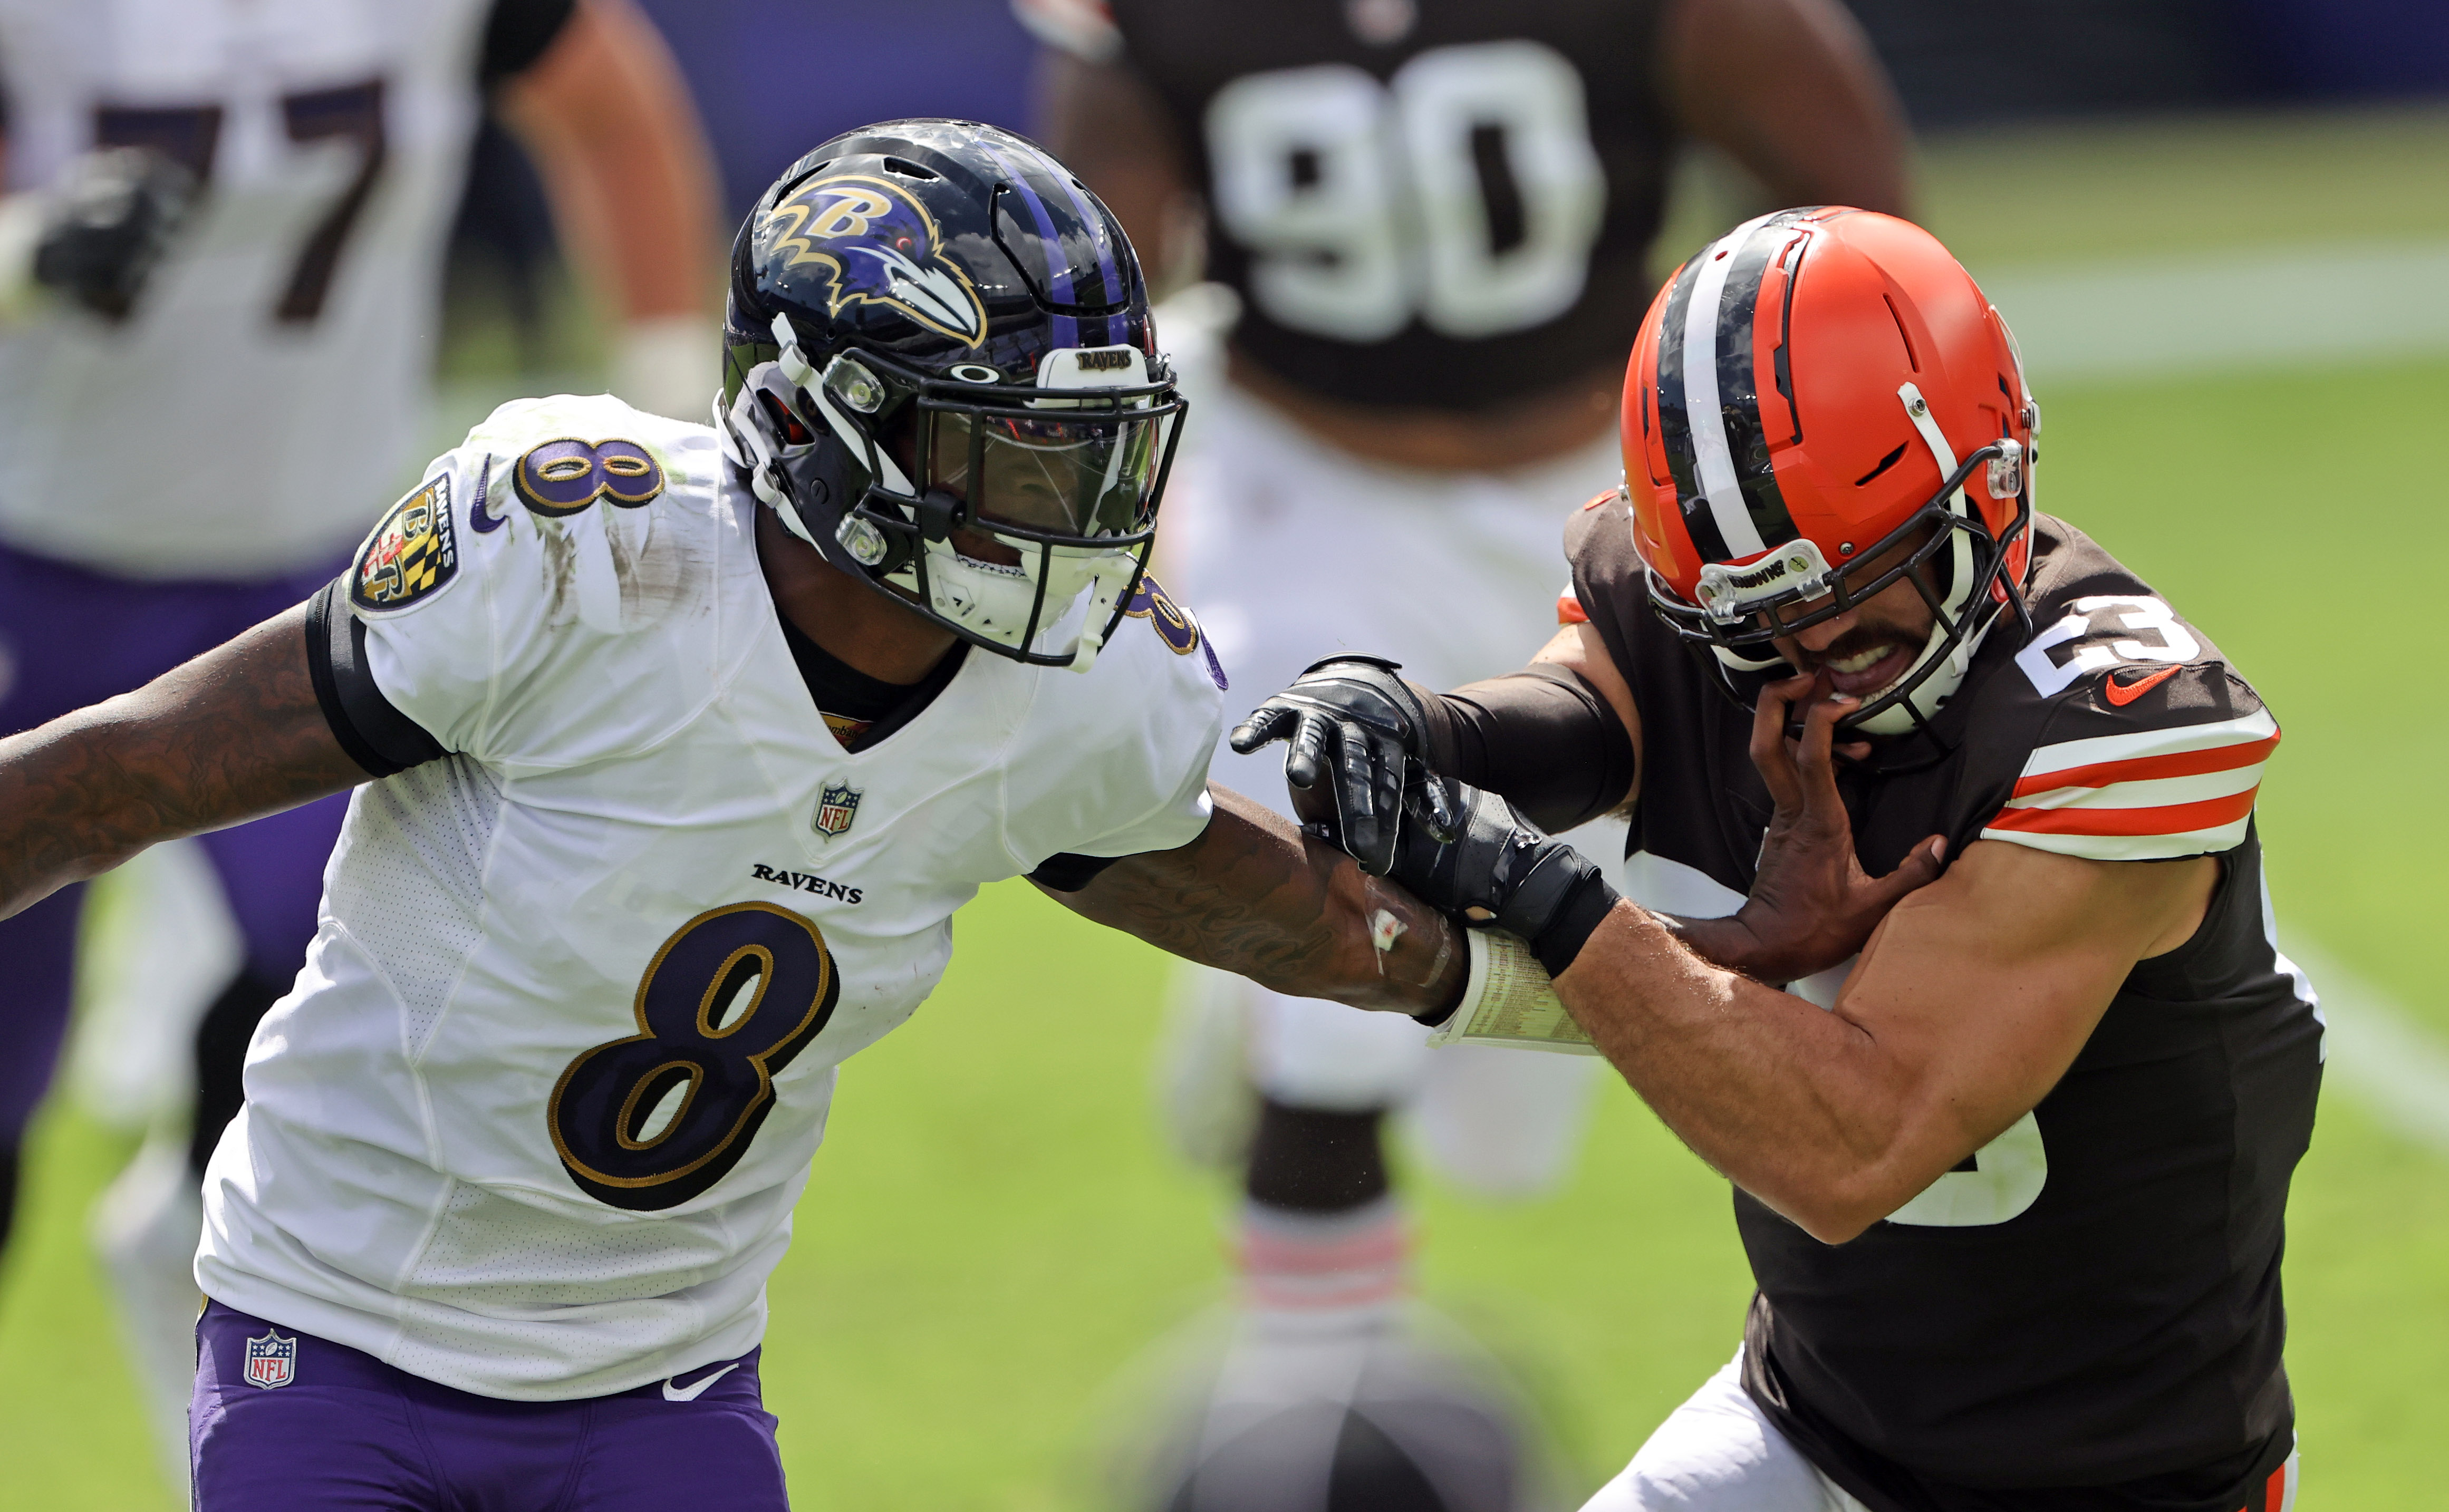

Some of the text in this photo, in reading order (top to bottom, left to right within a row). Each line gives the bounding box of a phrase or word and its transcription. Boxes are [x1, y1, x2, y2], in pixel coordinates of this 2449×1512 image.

[804, 187, 892, 239] B
[1201, 38, 1608, 344] 90
[1075, 349, 1132, 372] RAVENS
[513, 436, 667, 518] 8
[2014, 595, 2201, 700] 23
[818, 807, 849, 831] NFL
[750, 864, 864, 904] RAVENS
[547, 900, 841, 1213] 8
[252, 1359, 286, 1382] NFL
